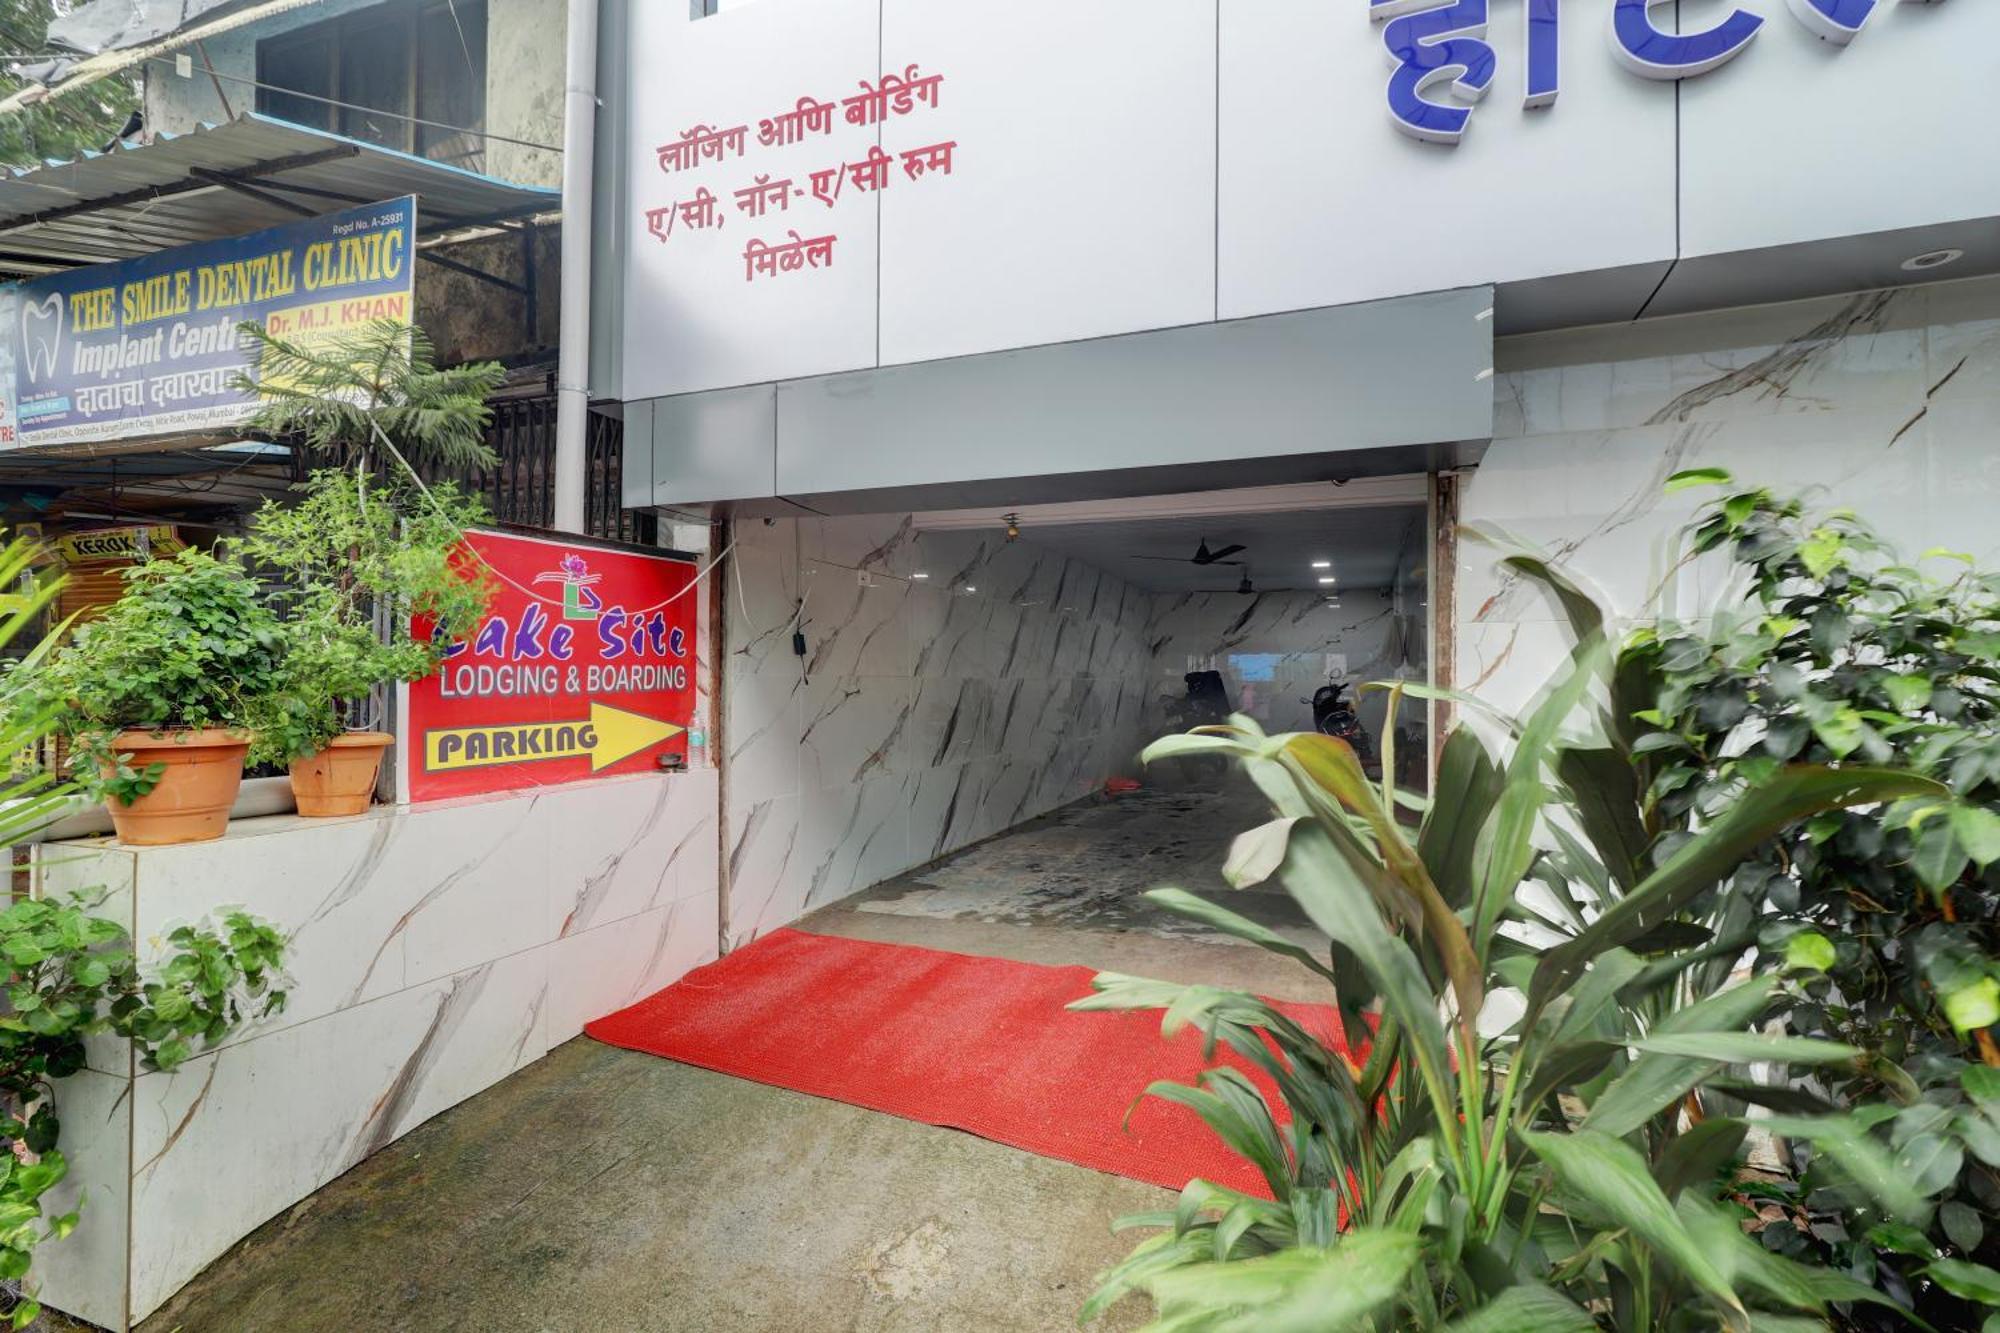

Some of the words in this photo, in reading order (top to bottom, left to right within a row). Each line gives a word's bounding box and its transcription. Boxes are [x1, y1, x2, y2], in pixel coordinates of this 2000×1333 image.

[656, 123, 749, 174] लॉजिंग
[757, 96, 837, 147] आणि
[842, 63, 945, 127] बोर्डिंग
[332, 221, 354, 236] Regd
[355, 219, 370, 231] No.
[371, 212, 404, 227] A-25931
[69, 286, 116, 334] THE
[122, 269, 191, 326] SMILE
[196, 249, 296, 310] DENTAL
[302, 228, 404, 292] CLINIC
[742, 229, 838, 282] मिळेल
[269, 315, 293, 337] Dr.
[298, 308, 334, 331] M.J.
[341, 296, 405, 325] KHAN
[72, 327, 165, 379] Implant
[597, 604, 688, 659] Site
[440, 663, 558, 697] LODGING
[565, 665, 581, 694] &
[586, 662, 687, 694] BOARDING
[437, 724, 599, 763] PARKING
